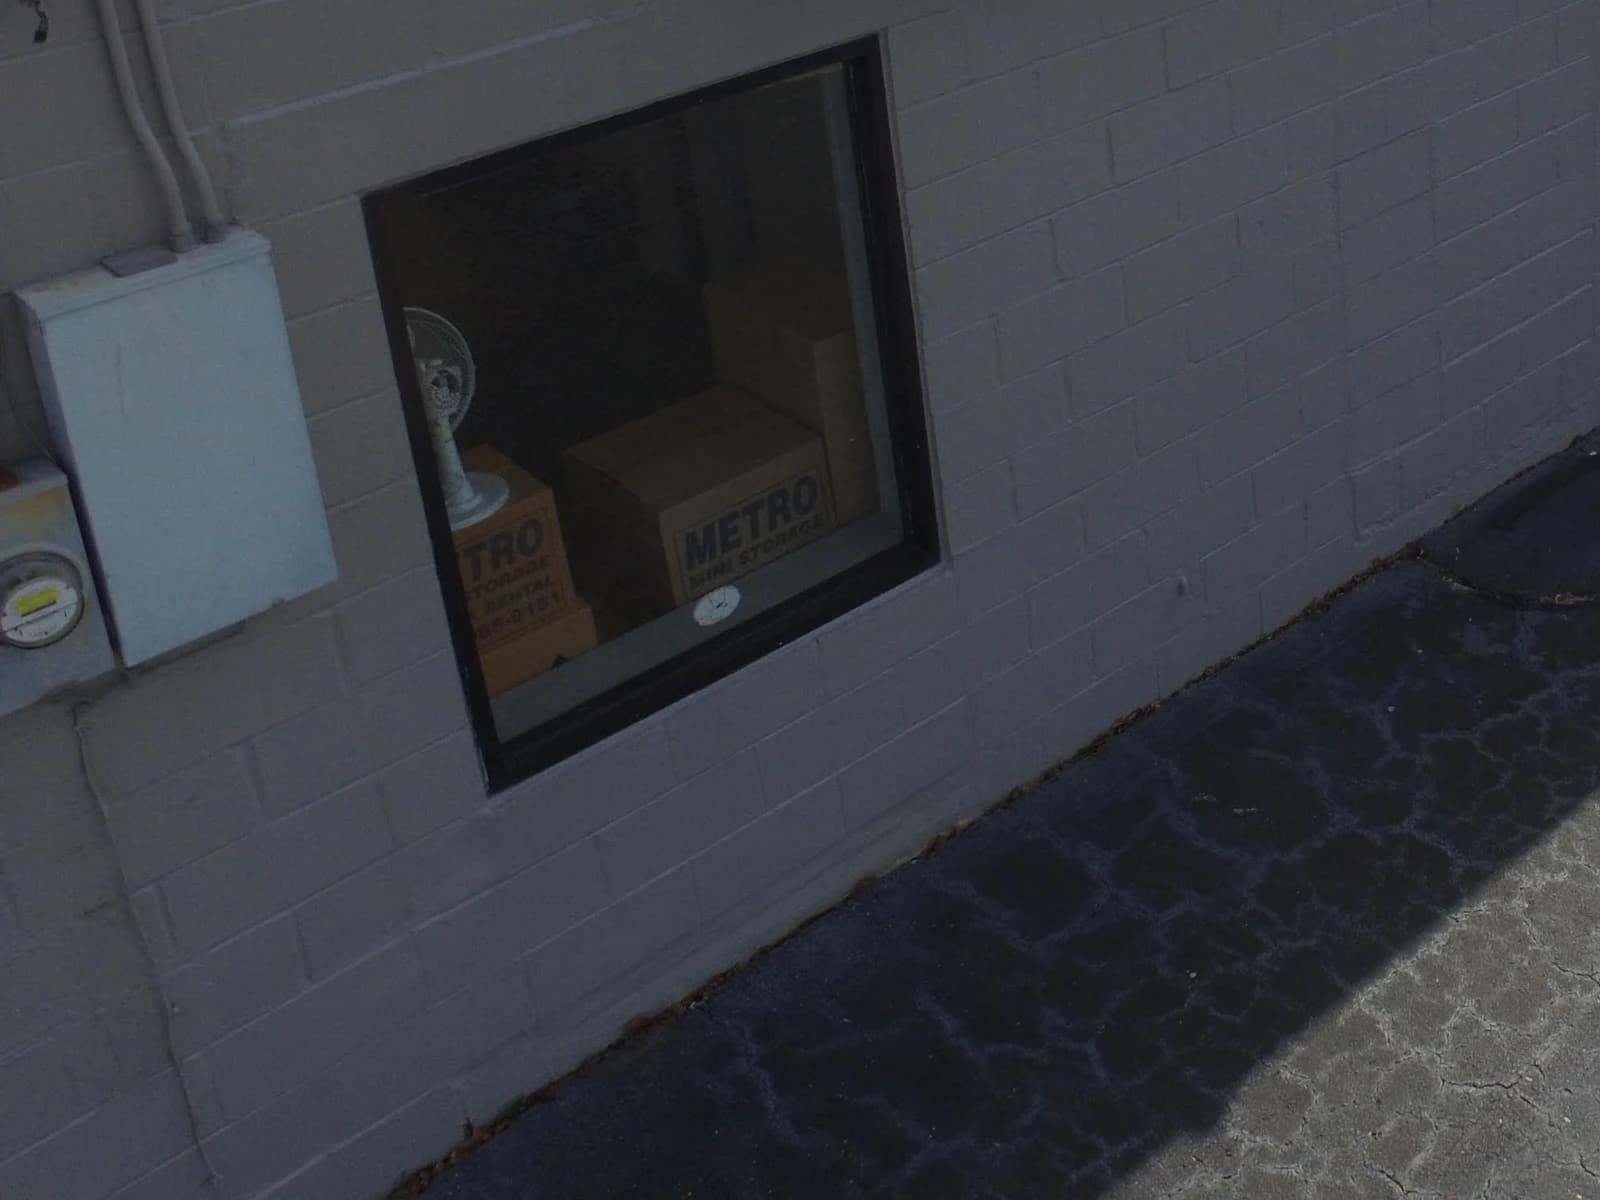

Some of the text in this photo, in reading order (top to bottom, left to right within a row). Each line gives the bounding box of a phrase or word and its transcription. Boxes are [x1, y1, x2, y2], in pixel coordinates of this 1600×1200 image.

[459, 517, 544, 581] TRO
[685, 475, 818, 571] METRO
[688, 511, 824, 591] MINI STORAGE
